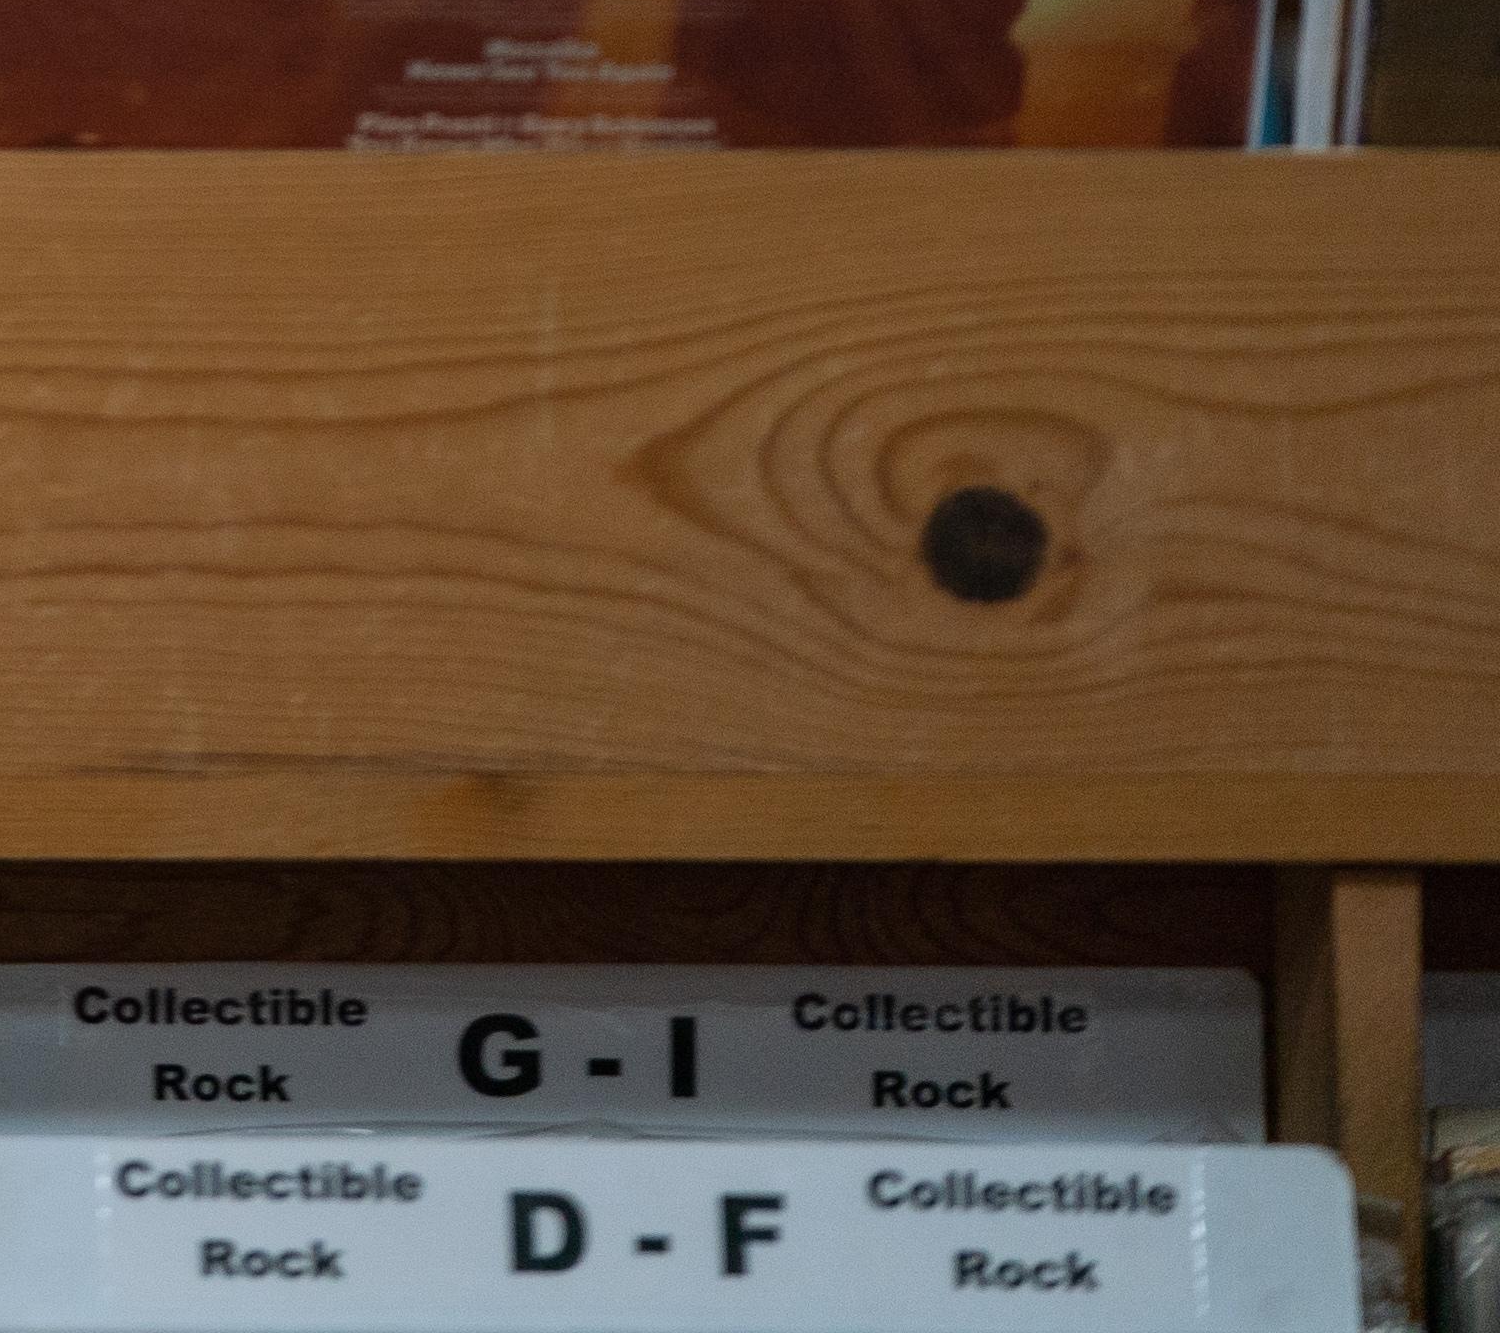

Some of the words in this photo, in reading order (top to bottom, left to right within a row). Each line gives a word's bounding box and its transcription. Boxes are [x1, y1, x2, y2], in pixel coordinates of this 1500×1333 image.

[73, 985, 369, 1027] Collectible
[792, 993, 1089, 1034] Collectible
[458, 1012, 542, 1098] G
[669, 1015, 697, 1098] I
[153, 1062, 291, 1102] Rock
[871, 1069, 1013, 1109] Rock
[113, 1159, 424, 1203] Collectible
[866, 1169, 1180, 1215] Collectible
[509, 1189, 589, 1273] D
[720, 1193, 785, 1277] F
[199, 1239, 345, 1279] Rock
[952, 1249, 1102, 1292] Rock
